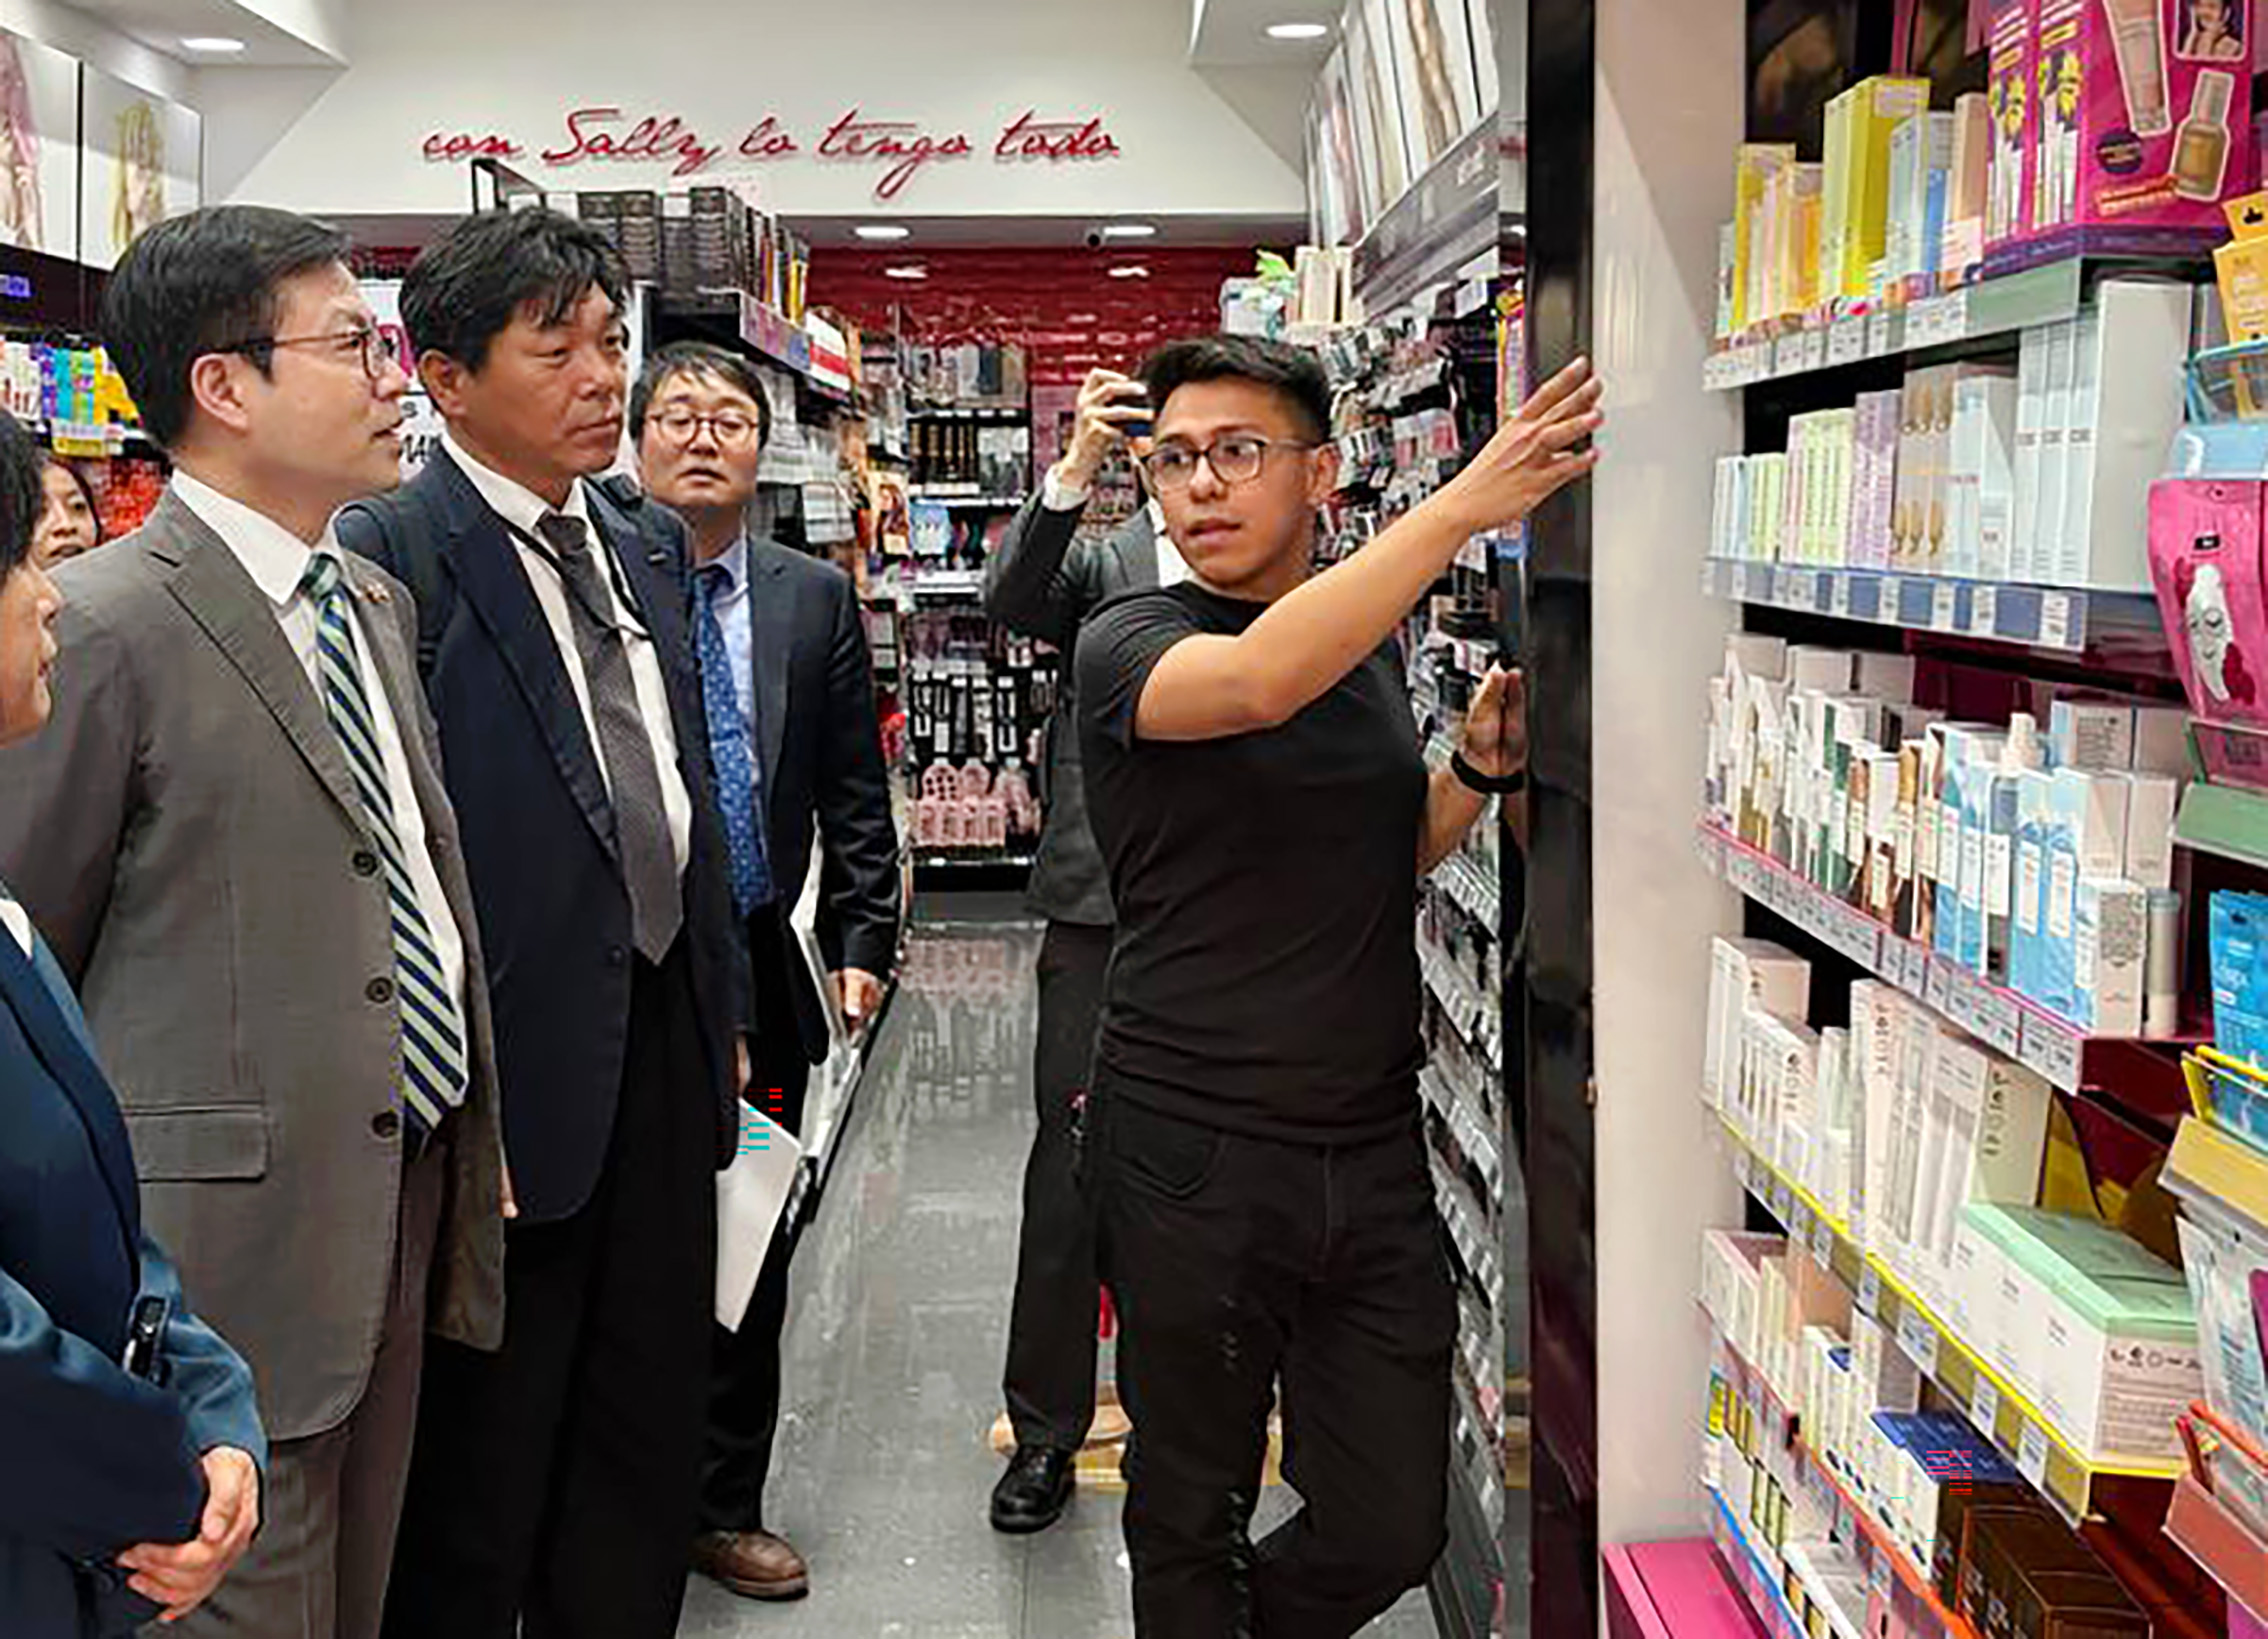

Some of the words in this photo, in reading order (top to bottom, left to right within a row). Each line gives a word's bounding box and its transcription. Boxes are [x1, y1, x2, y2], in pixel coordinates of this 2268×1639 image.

[423, 134, 522, 159] con
[543, 108, 716, 175] Sally
[740, 117, 798, 157] lo
[819, 109, 970, 199] tengo
[994, 110, 1120, 158] todo
